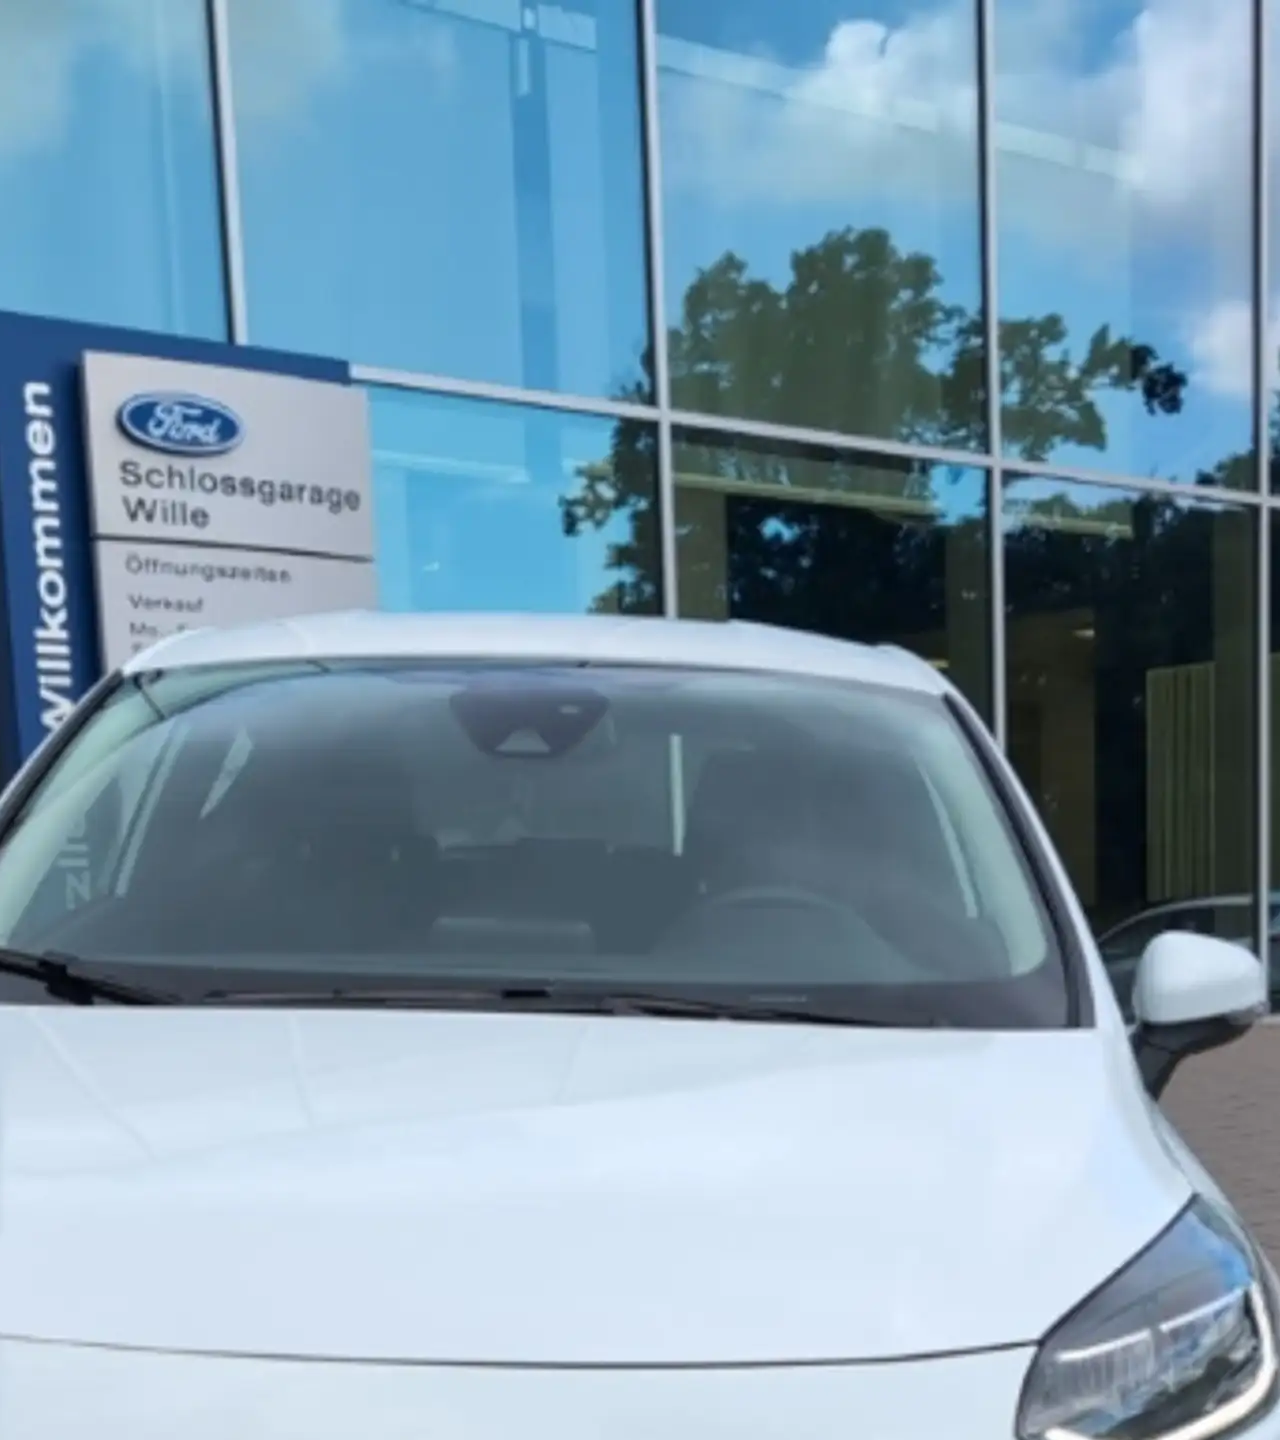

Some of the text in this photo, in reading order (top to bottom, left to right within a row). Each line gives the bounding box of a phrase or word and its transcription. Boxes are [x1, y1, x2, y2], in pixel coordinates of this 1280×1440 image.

[147, 402, 222, 444] Ford
[119, 460, 362, 515] Schlossgarage
[121, 495, 210, 529] Wille
